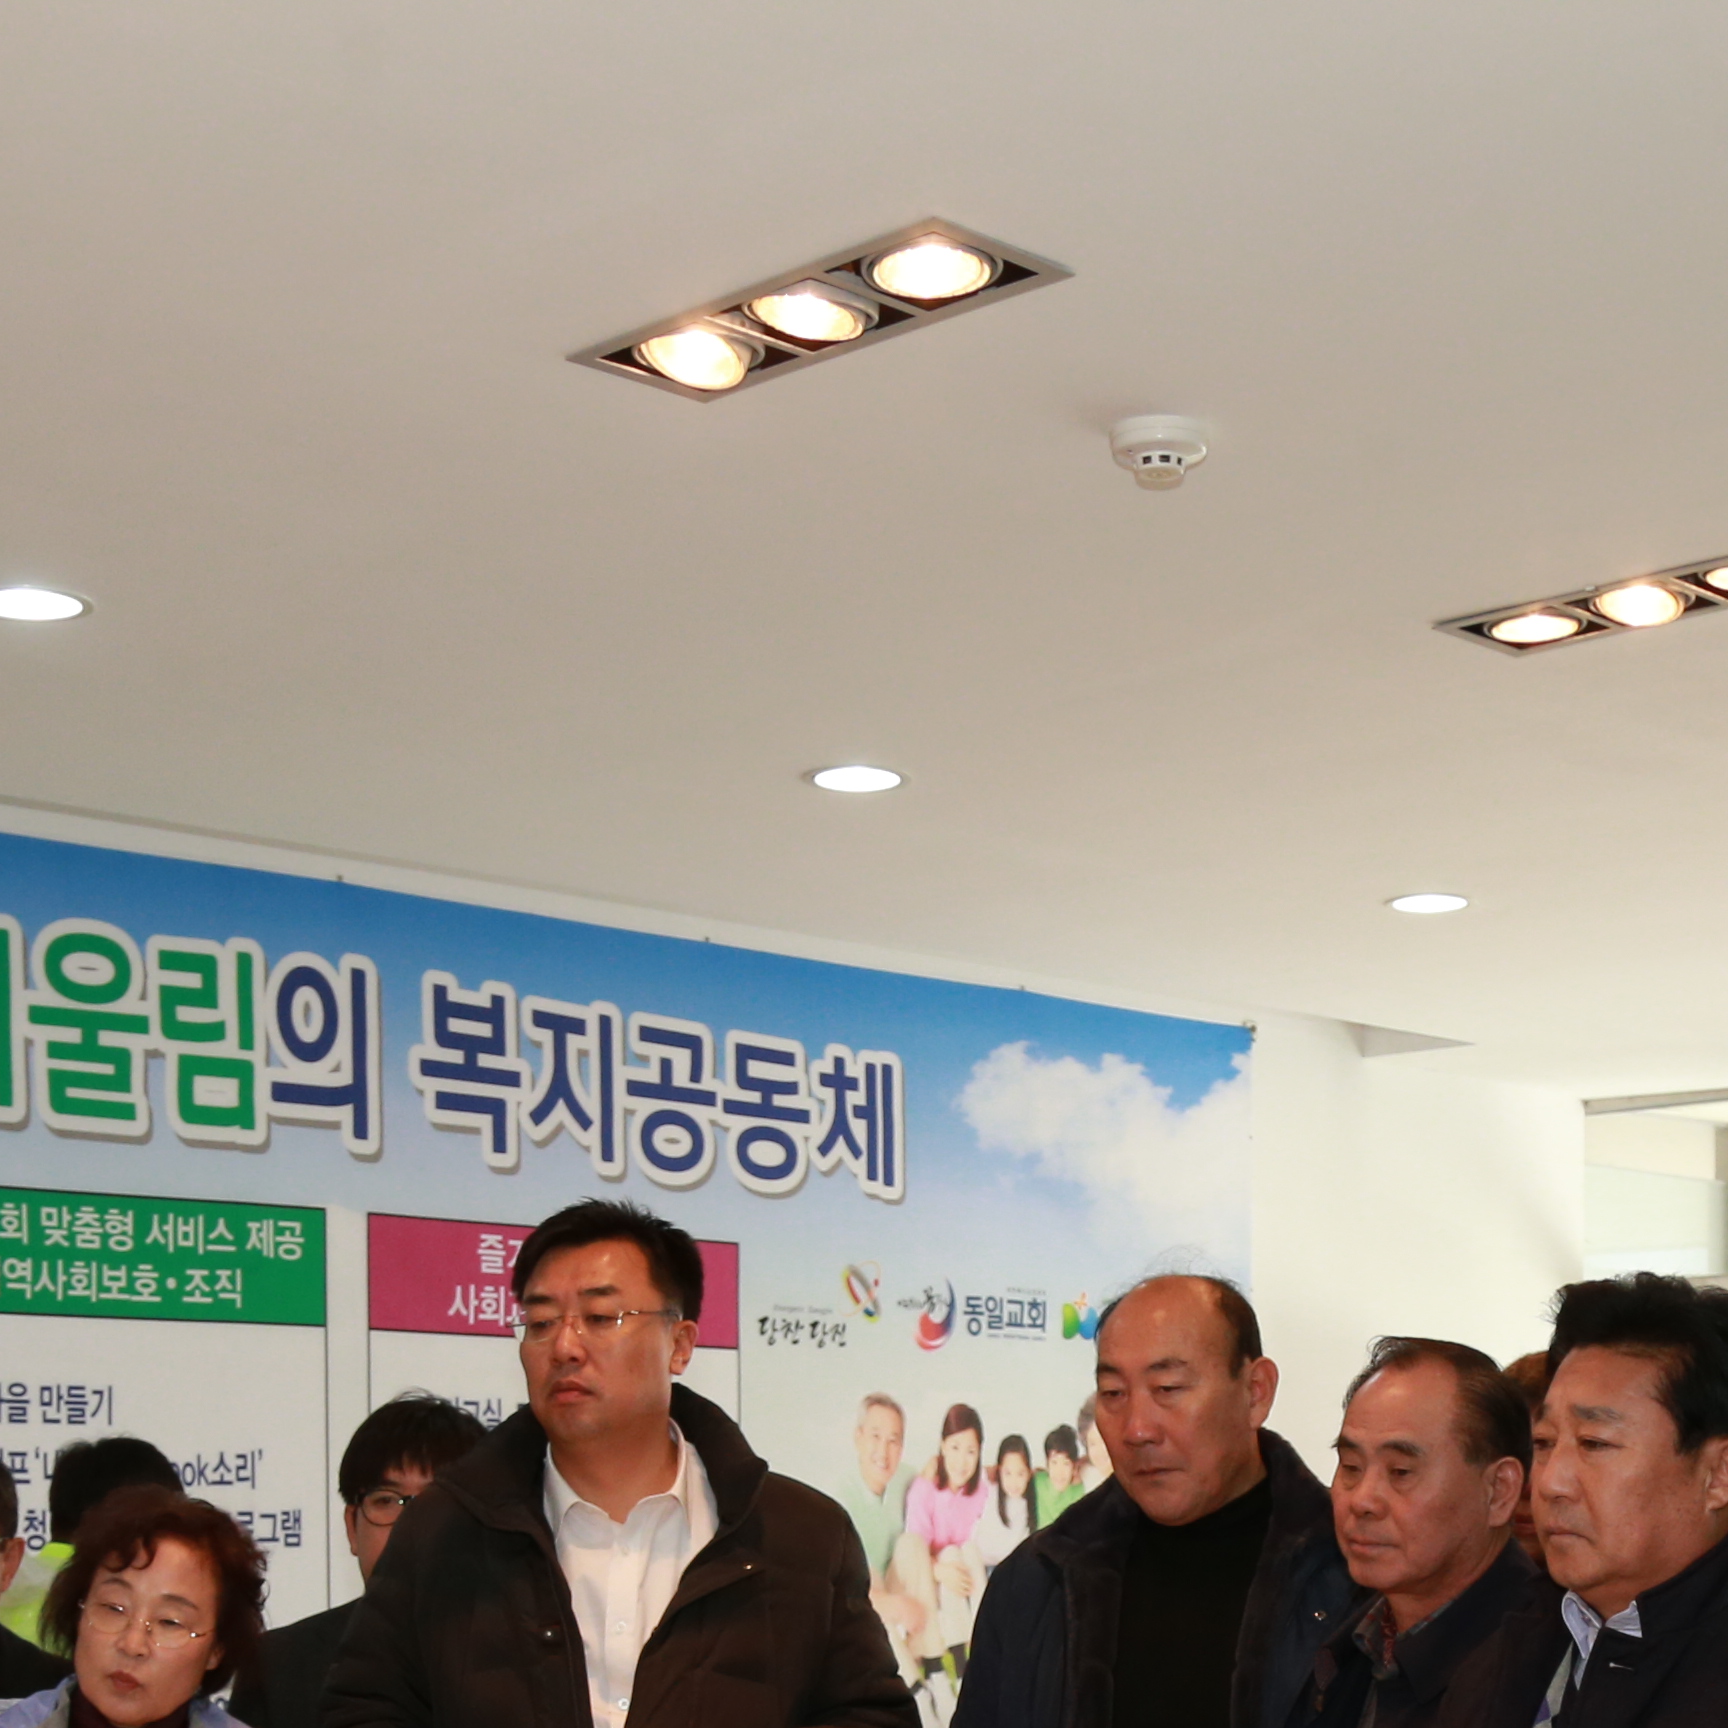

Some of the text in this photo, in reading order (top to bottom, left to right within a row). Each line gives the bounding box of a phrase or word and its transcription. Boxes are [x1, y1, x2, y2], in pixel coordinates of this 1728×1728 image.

[415, 976, 900, 1196] 복지공동체
[40, 1206, 134, 1252] 맞춤형
[145, 1213, 237, 1255] 서비스
[246, 1218, 305, 1261] 제공
[963, 1296, 1047, 1336] 동일교회
[40, 1384, 113, 1426] 만들기
